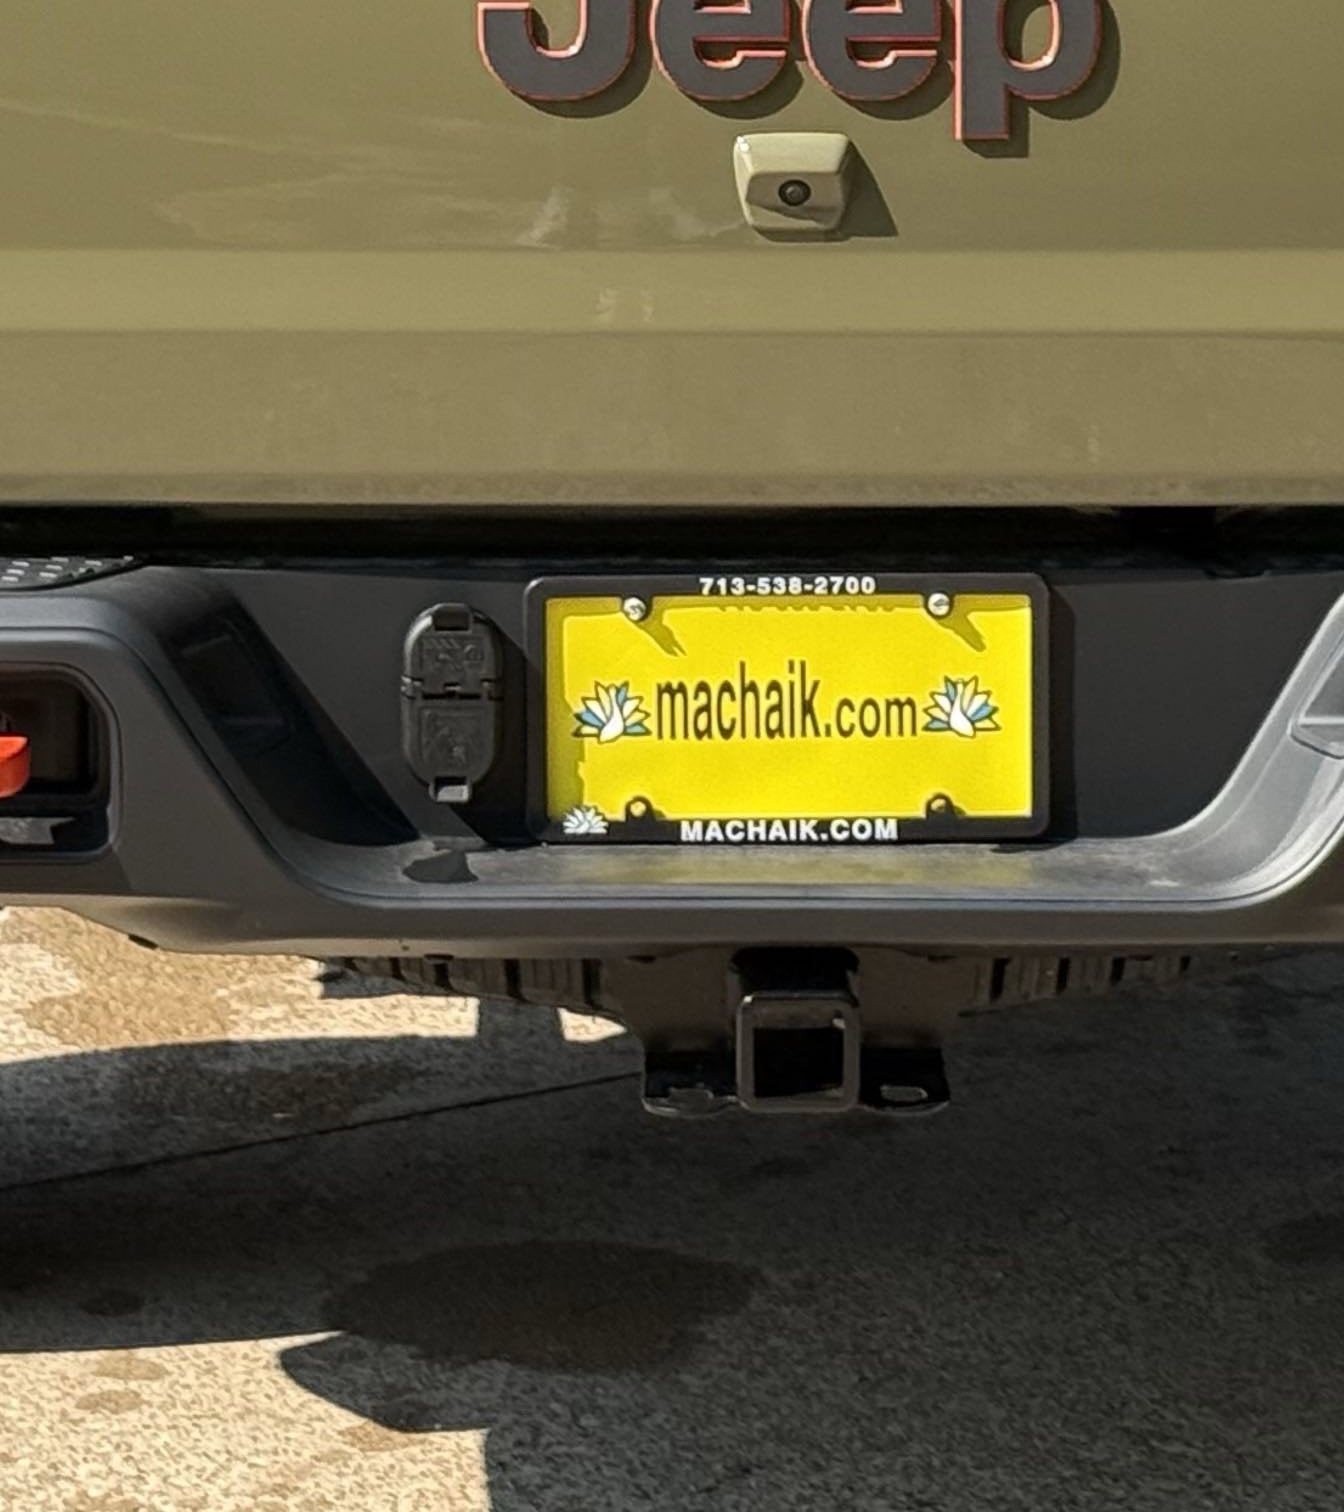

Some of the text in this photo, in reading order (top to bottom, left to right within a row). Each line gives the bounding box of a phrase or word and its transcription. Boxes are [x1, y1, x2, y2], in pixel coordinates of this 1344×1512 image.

[699, 576, 877, 596] 713-538-2700
[655, 660, 919, 741] machaik.com
[679, 818, 899, 842] MACHAIK.COM
